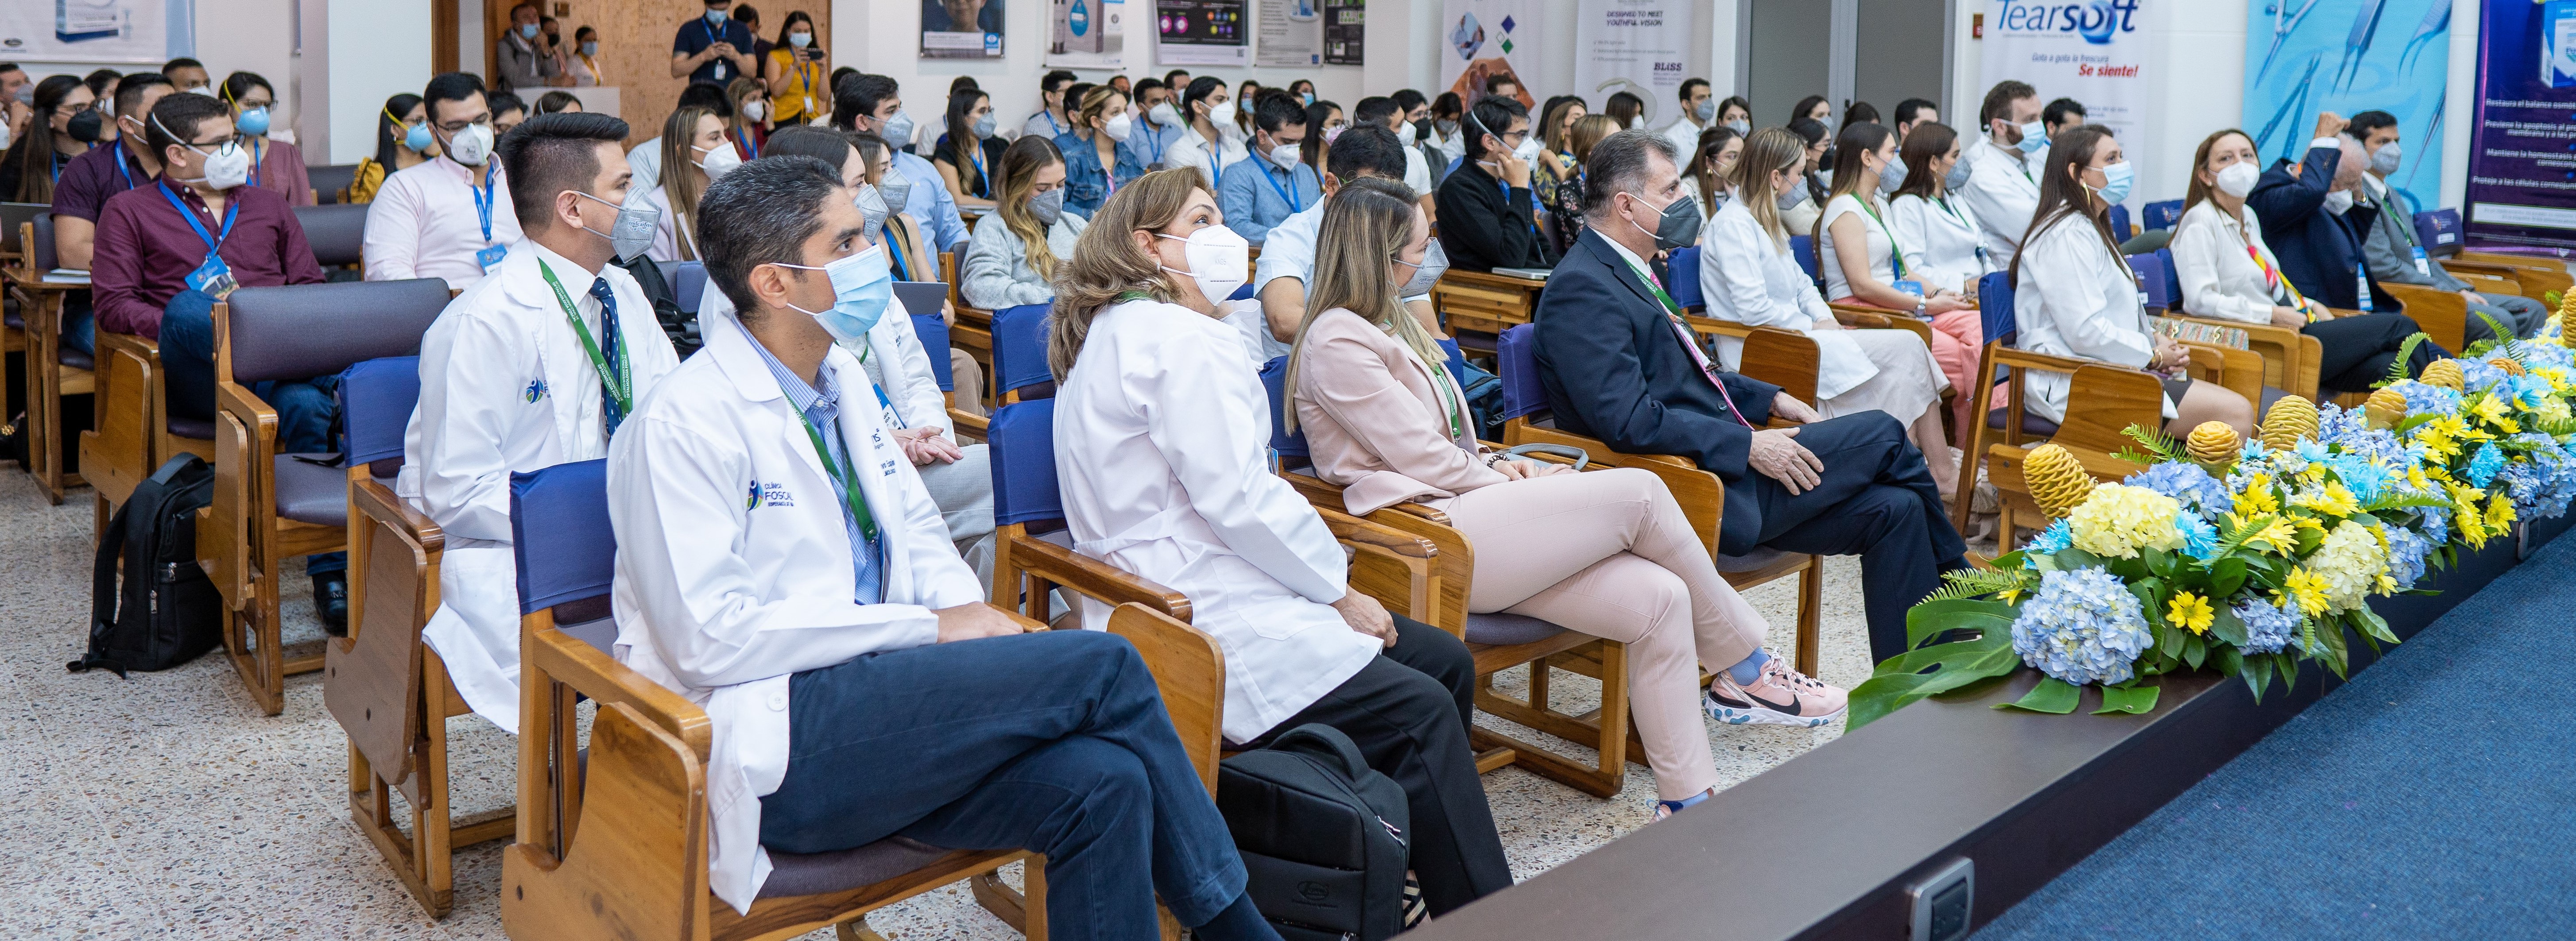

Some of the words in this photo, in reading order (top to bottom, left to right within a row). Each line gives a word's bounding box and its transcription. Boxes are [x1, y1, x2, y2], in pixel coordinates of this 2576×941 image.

[1996, 0, 2138, 32] Tearsoft
[2079, 63, 2093, 76] Se
[2097, 64, 2138, 77] siente!
[2486, 98, 2517, 107] Restaura
[2485, 120, 2514, 128] Previene
[2507, 129, 2545, 137] membrana
[2528, 150, 2572, 160] homeostasis
[2515, 179, 2539, 188] células
[568, 308, 576, 322] FOSCAL
[612, 390, 620, 402] FOSCAL
[765, 491, 794, 501] FOSCAL
